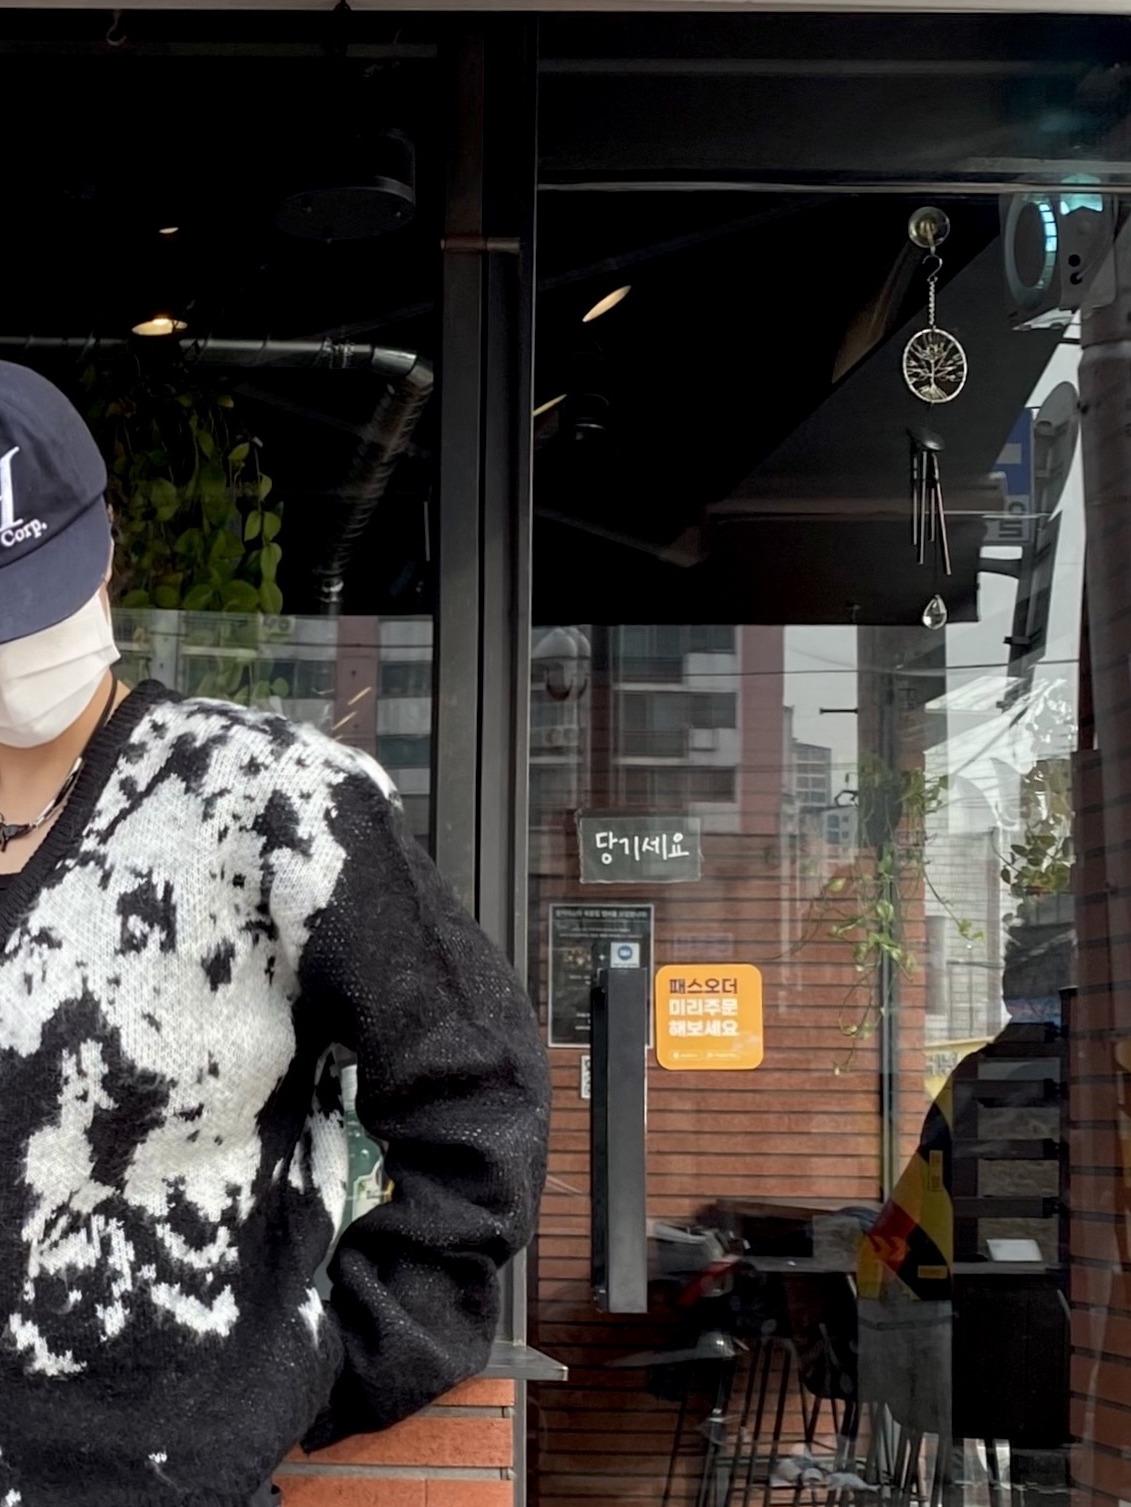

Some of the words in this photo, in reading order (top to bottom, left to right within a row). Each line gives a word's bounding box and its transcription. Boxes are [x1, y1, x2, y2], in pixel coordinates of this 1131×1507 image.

[0, 518, 47, 547] Corp.
[595, 831, 689, 864] 당기세요
[669, 978, 738, 994] 패스오더
[669, 998, 738, 1016] 미리주문
[668, 1020, 739, 1037] 해보세요
